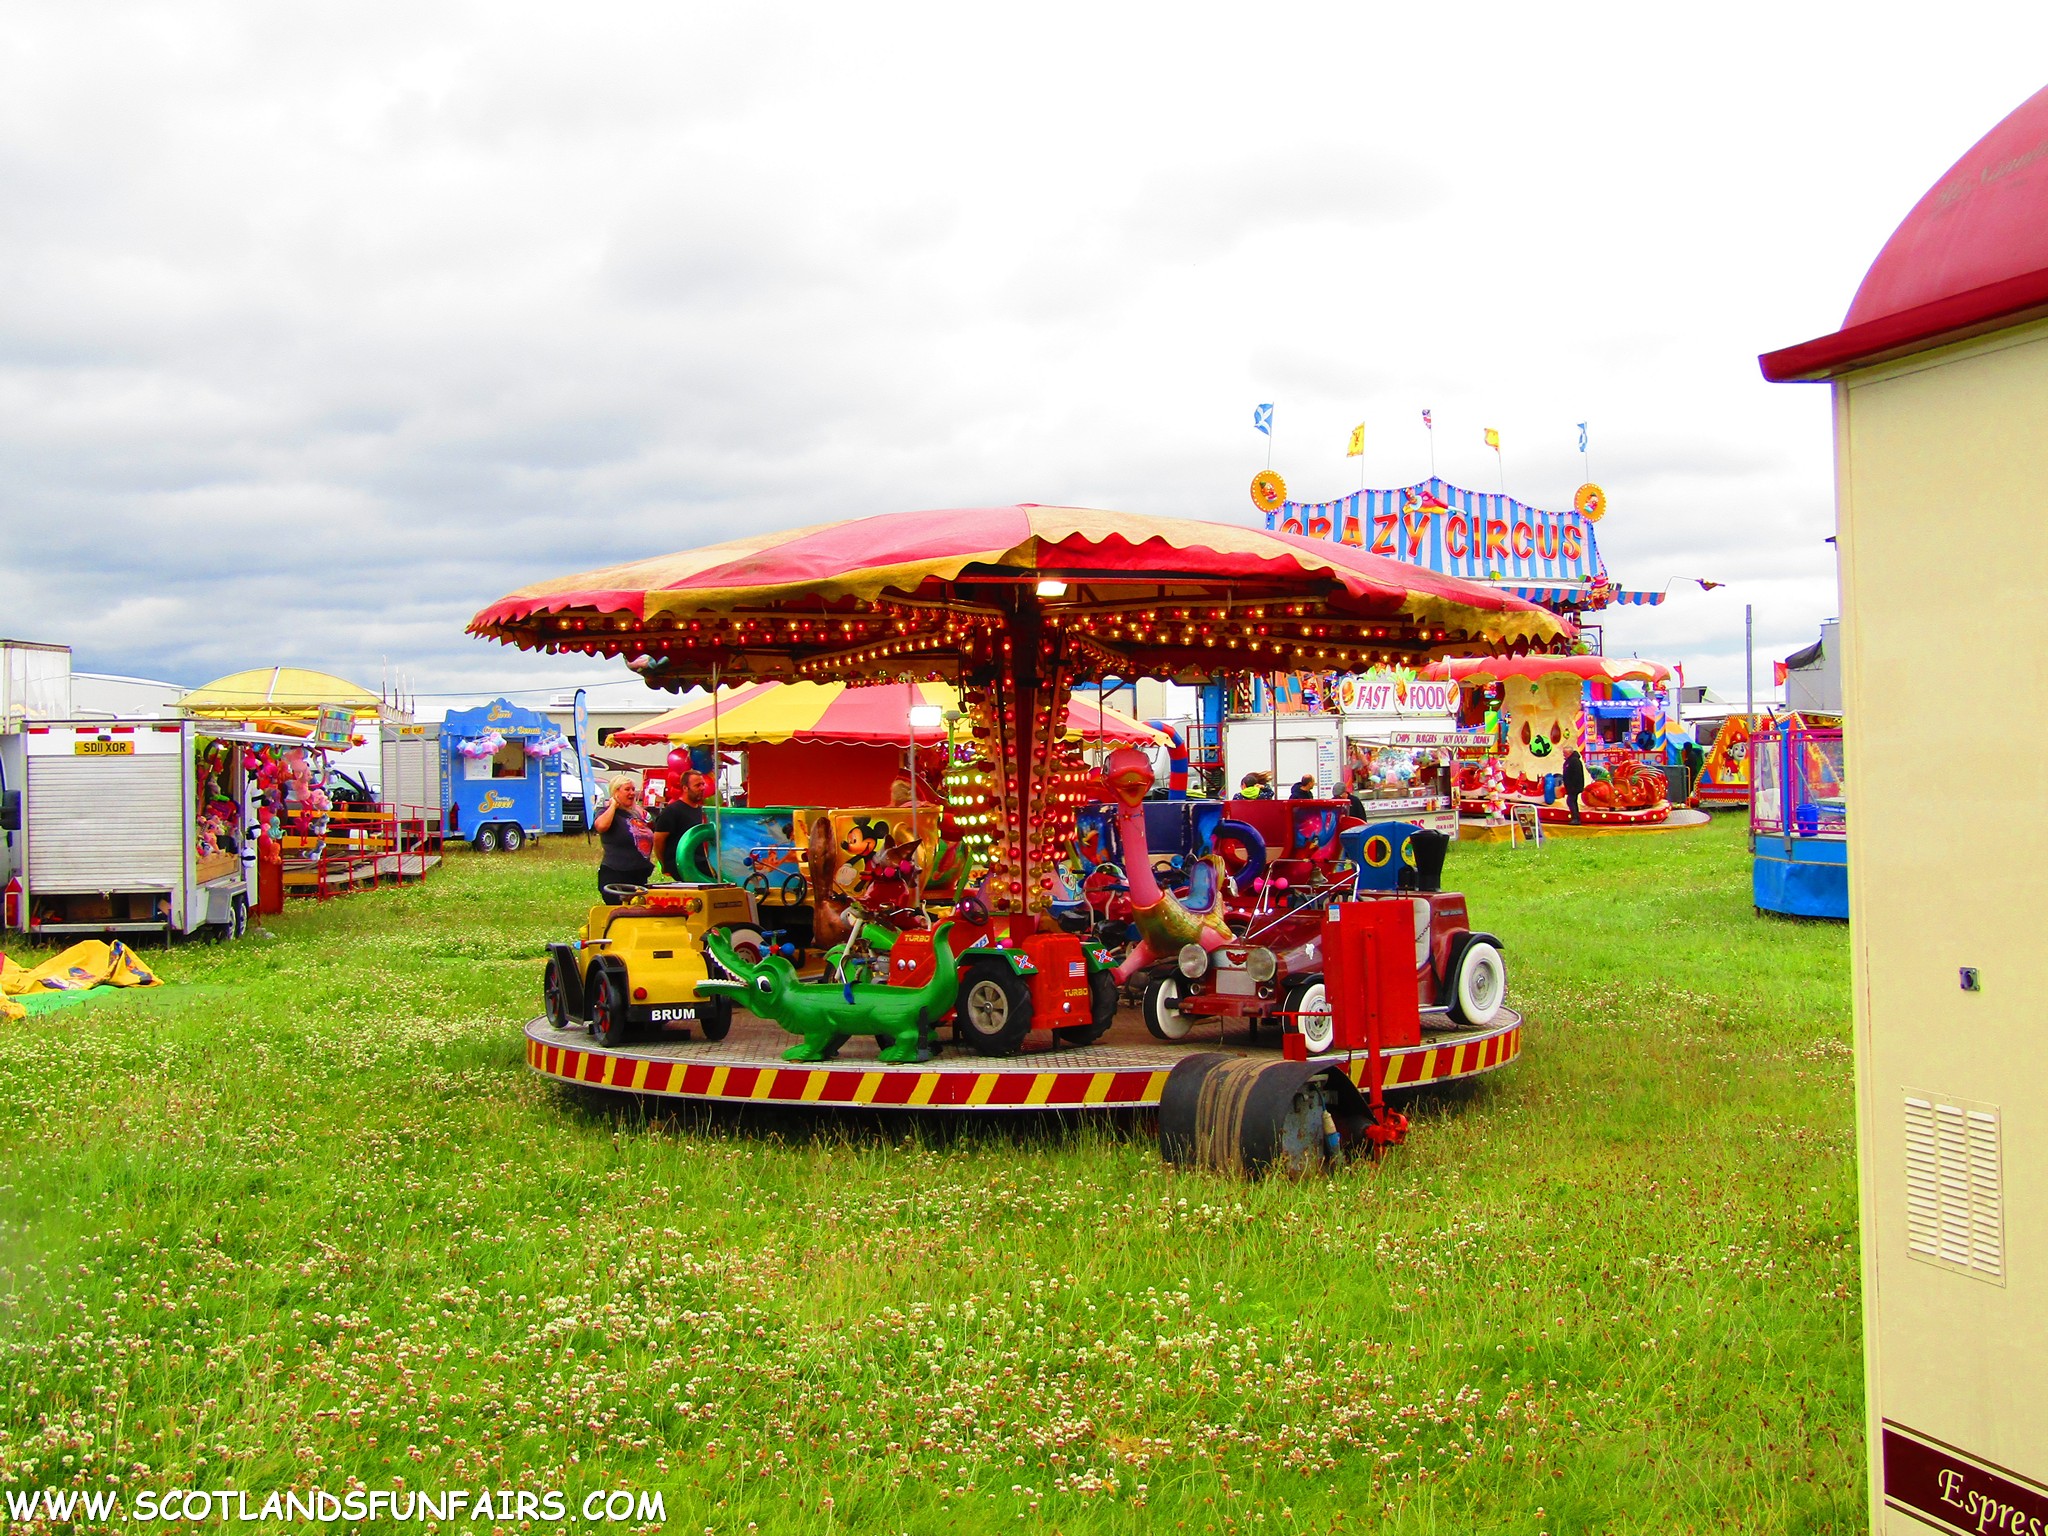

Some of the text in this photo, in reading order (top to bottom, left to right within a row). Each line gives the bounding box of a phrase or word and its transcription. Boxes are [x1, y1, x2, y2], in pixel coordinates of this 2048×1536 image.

[1446, 514, 1583, 561] CIRCUS
[1356, 685, 1446, 710] FAST FOOD
[1395, 733, 1491, 745] CHIPS BURGERS HOT DOGS DRINKS
[105, 742, 126, 752] XOR
[904, 934, 931, 943] TURBO
[1063, 987, 1089, 997] TURBO
[651, 1008, 696, 1021] BRUM
[1938, 1468, 2048, 1536] Espres
